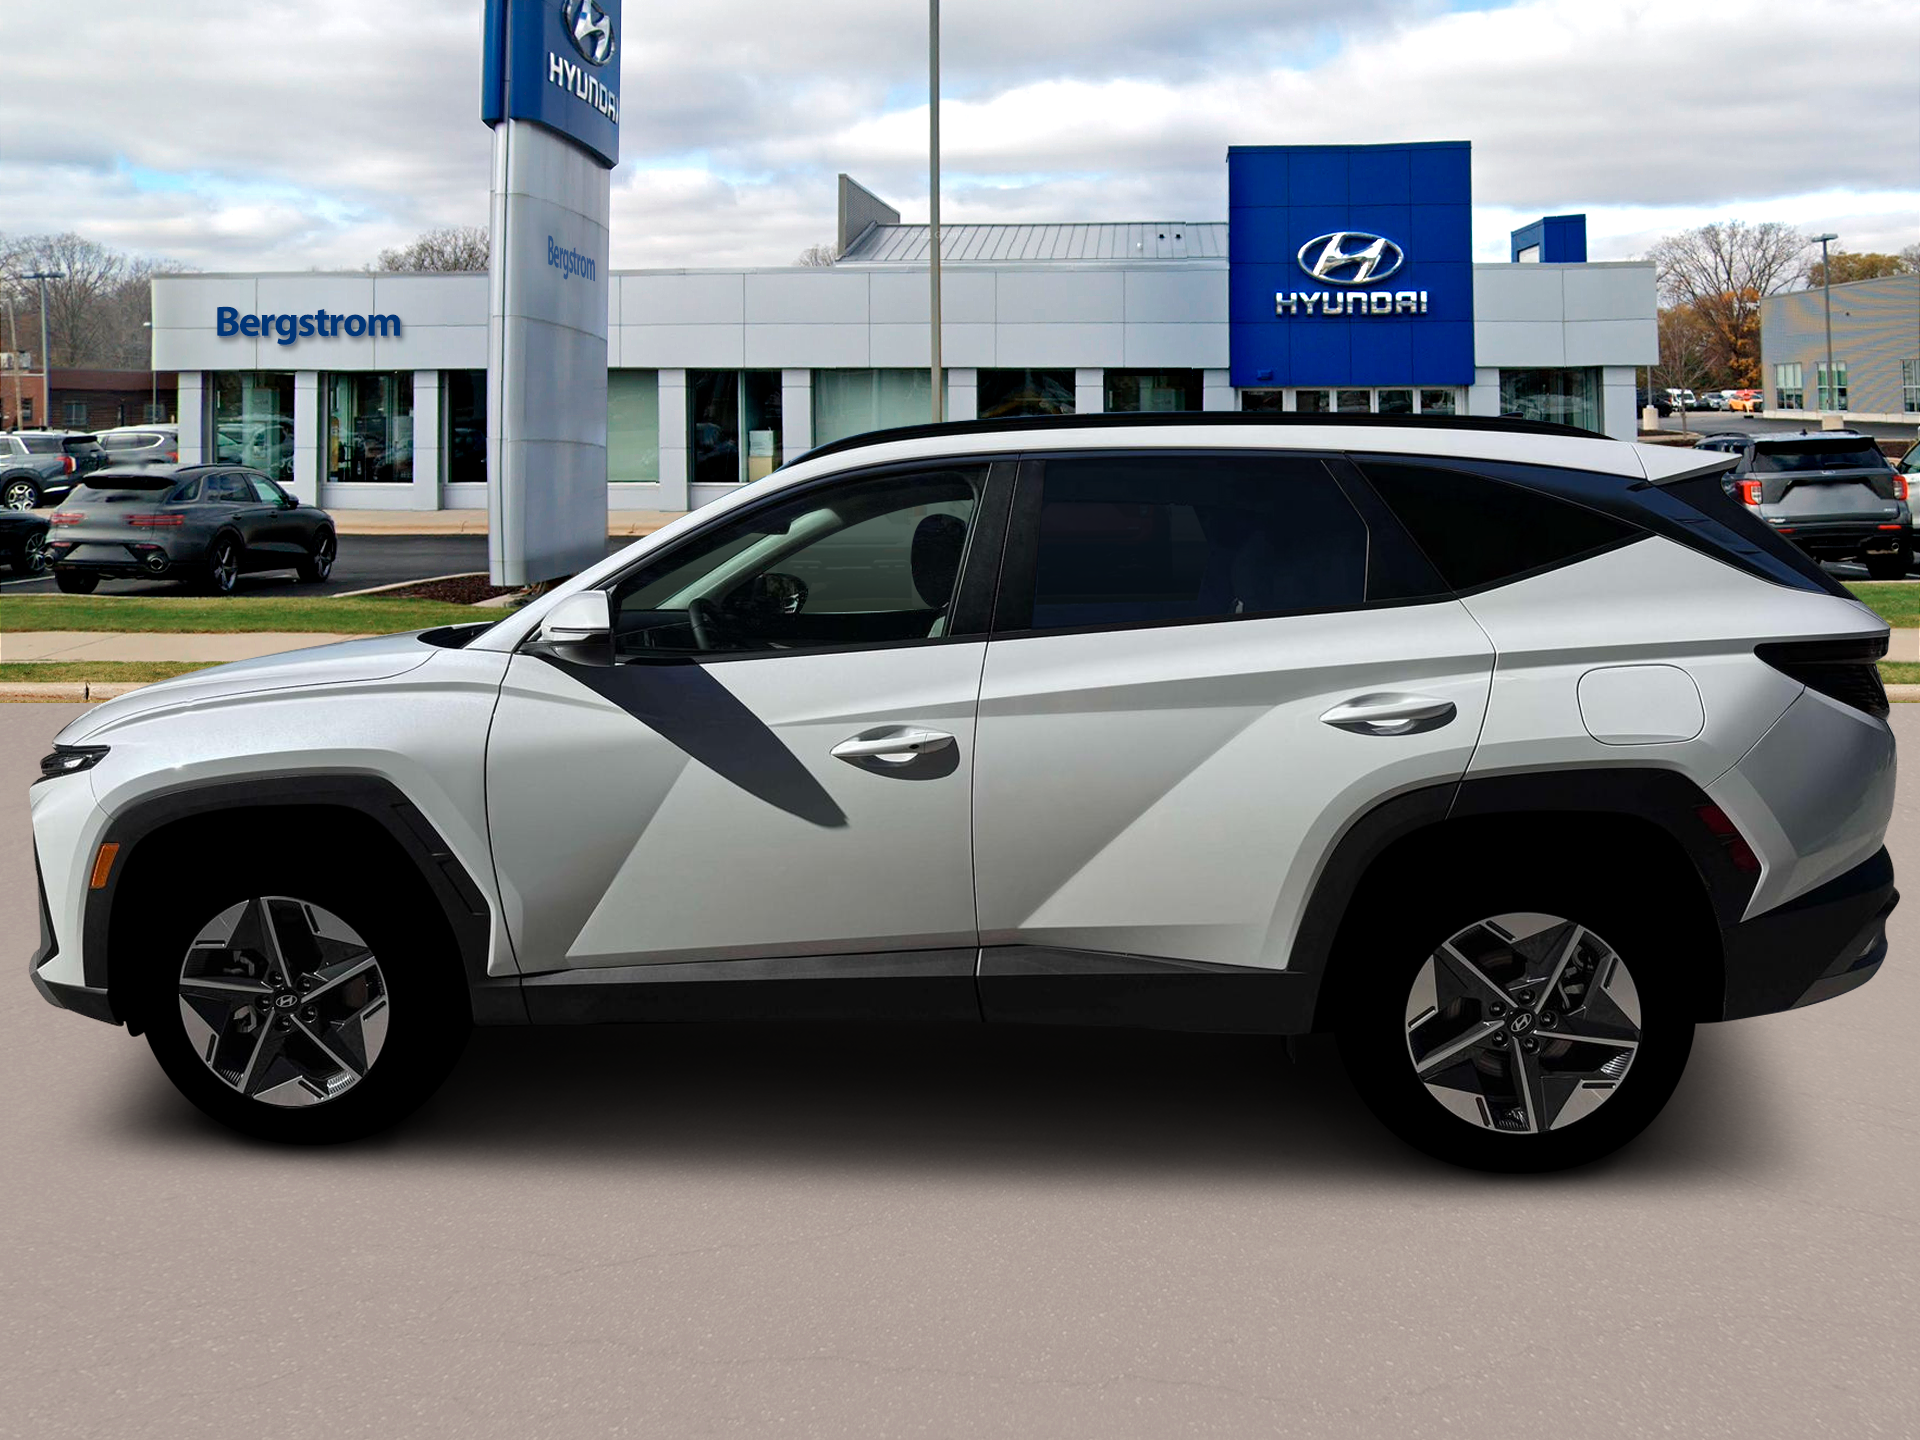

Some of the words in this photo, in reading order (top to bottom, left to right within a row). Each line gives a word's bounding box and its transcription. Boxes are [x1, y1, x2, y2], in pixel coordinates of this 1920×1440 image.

[548, 51, 619, 124] HYUNDAI
[547, 235, 596, 282] Bergstrom
[1275, 291, 1428, 315] HYUNDAI
[216, 306, 401, 346] Bergstrom
